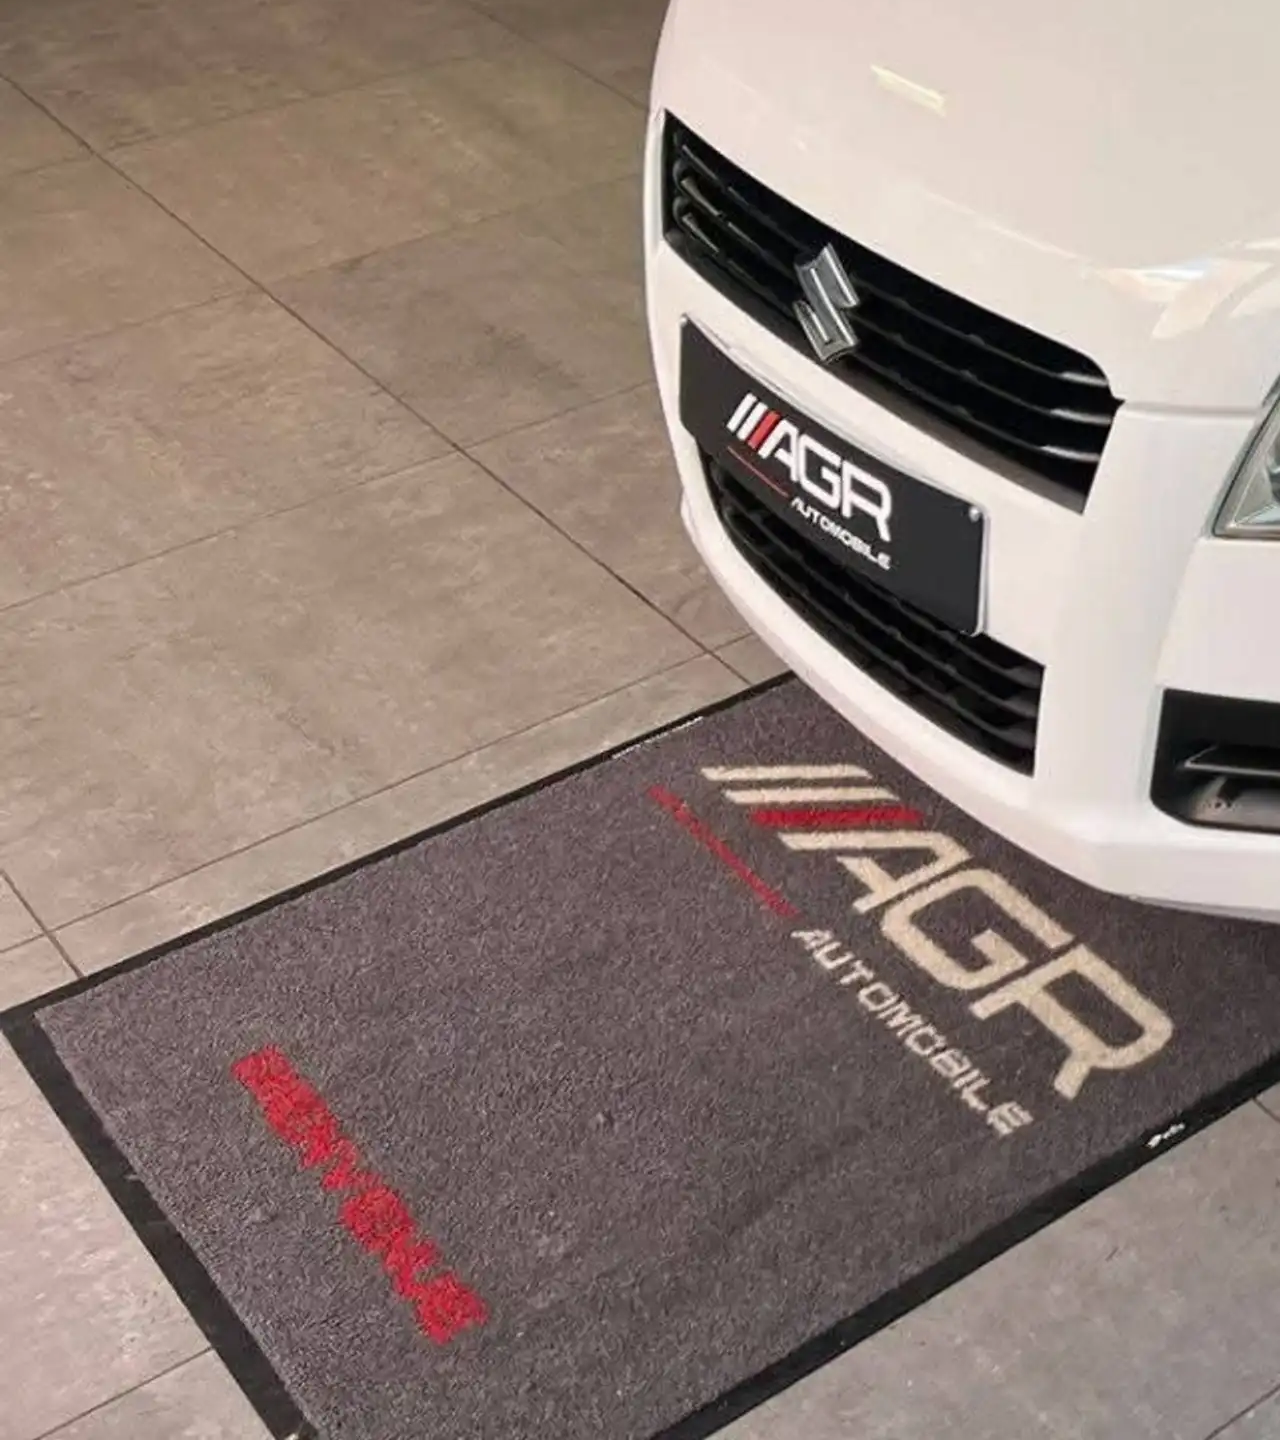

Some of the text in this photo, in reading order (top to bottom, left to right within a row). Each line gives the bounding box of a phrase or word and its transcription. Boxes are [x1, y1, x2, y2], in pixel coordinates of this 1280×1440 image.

[757, 418, 892, 543] AGR
[790, 497, 891, 571] AUTOMOBILE
[778, 830, 1175, 1101] AGR
[791, 929, 1034, 1136] AUTOMOBILE
